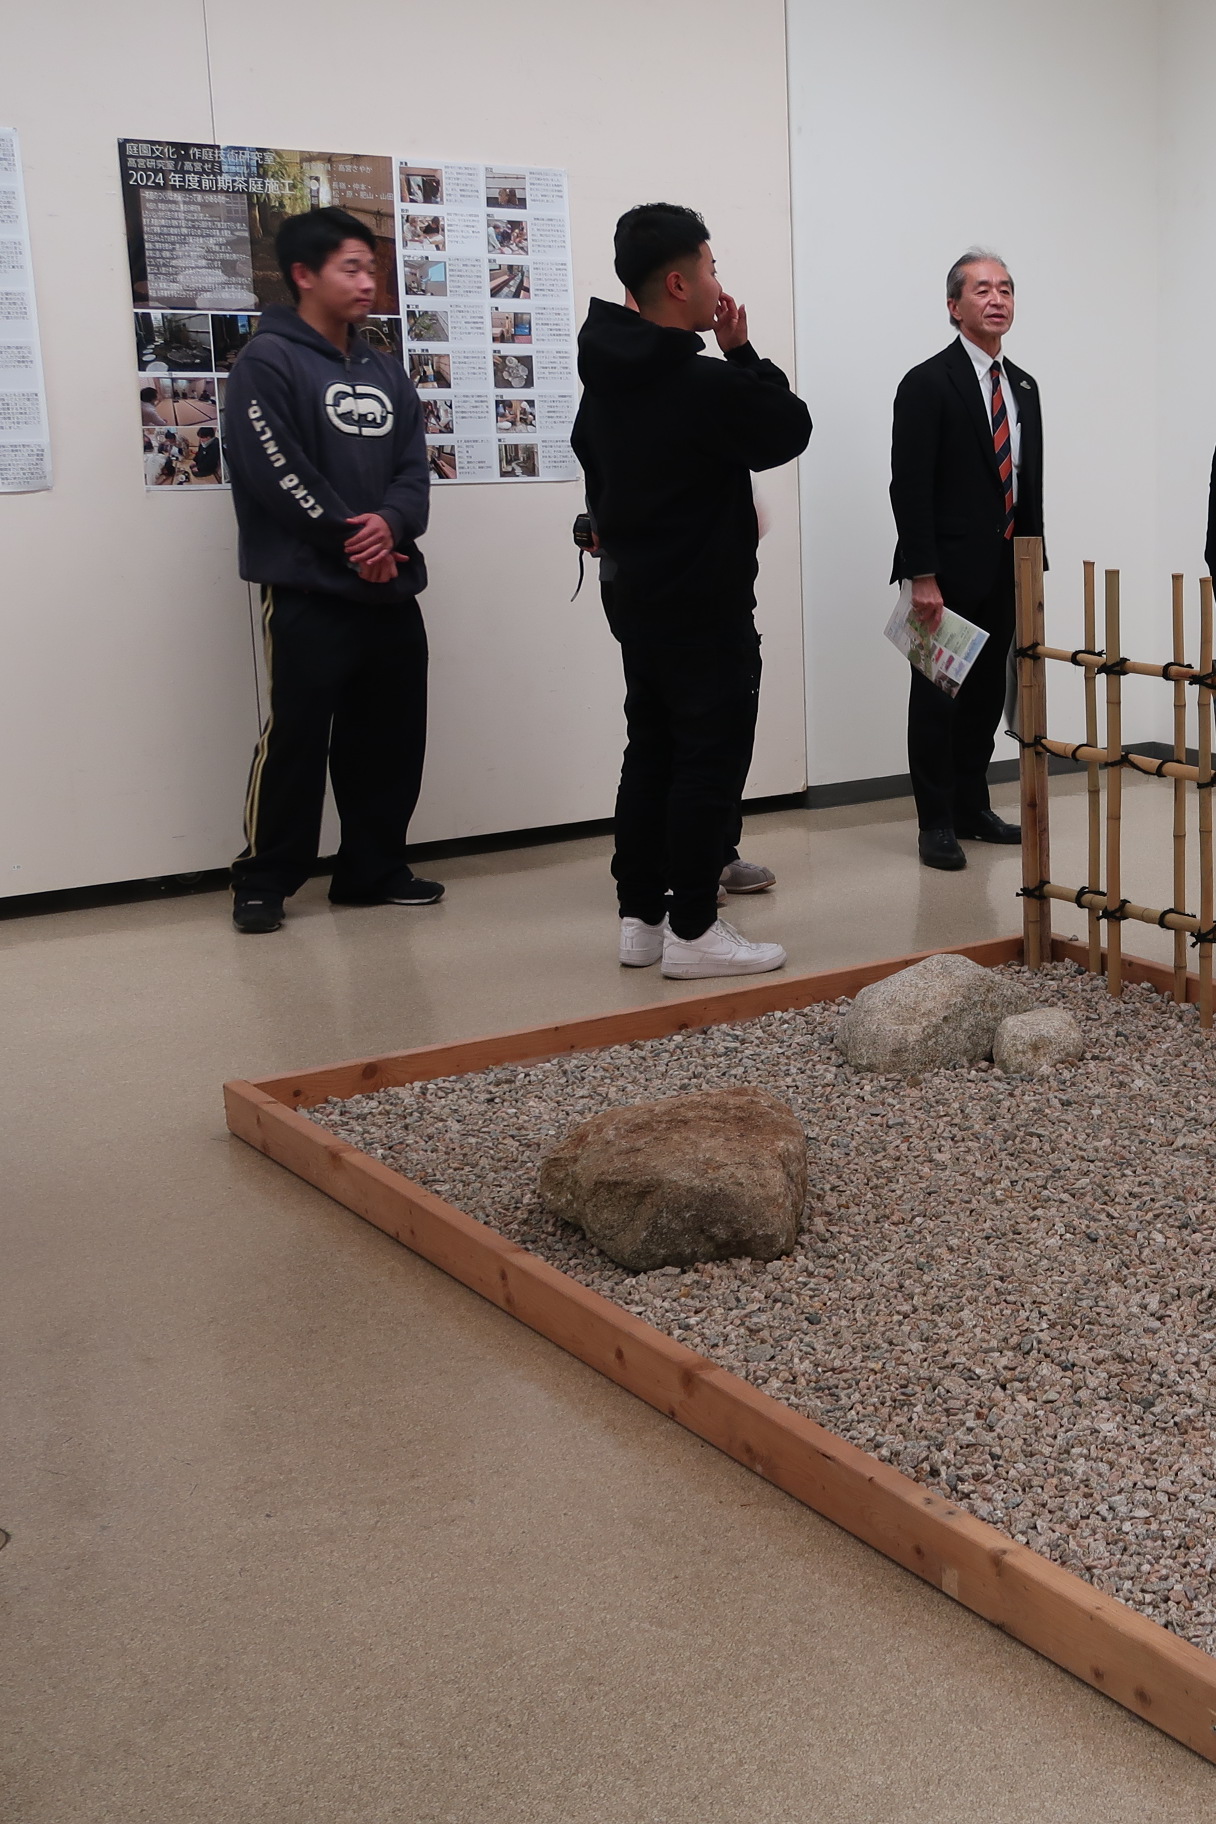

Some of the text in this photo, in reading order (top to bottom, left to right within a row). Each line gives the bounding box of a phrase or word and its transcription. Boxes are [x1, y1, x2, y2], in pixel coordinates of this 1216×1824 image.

[126, 142, 277, 165] 庭園文化・作庭技術研究室
[247, 399, 287, 468] UNLTD.
